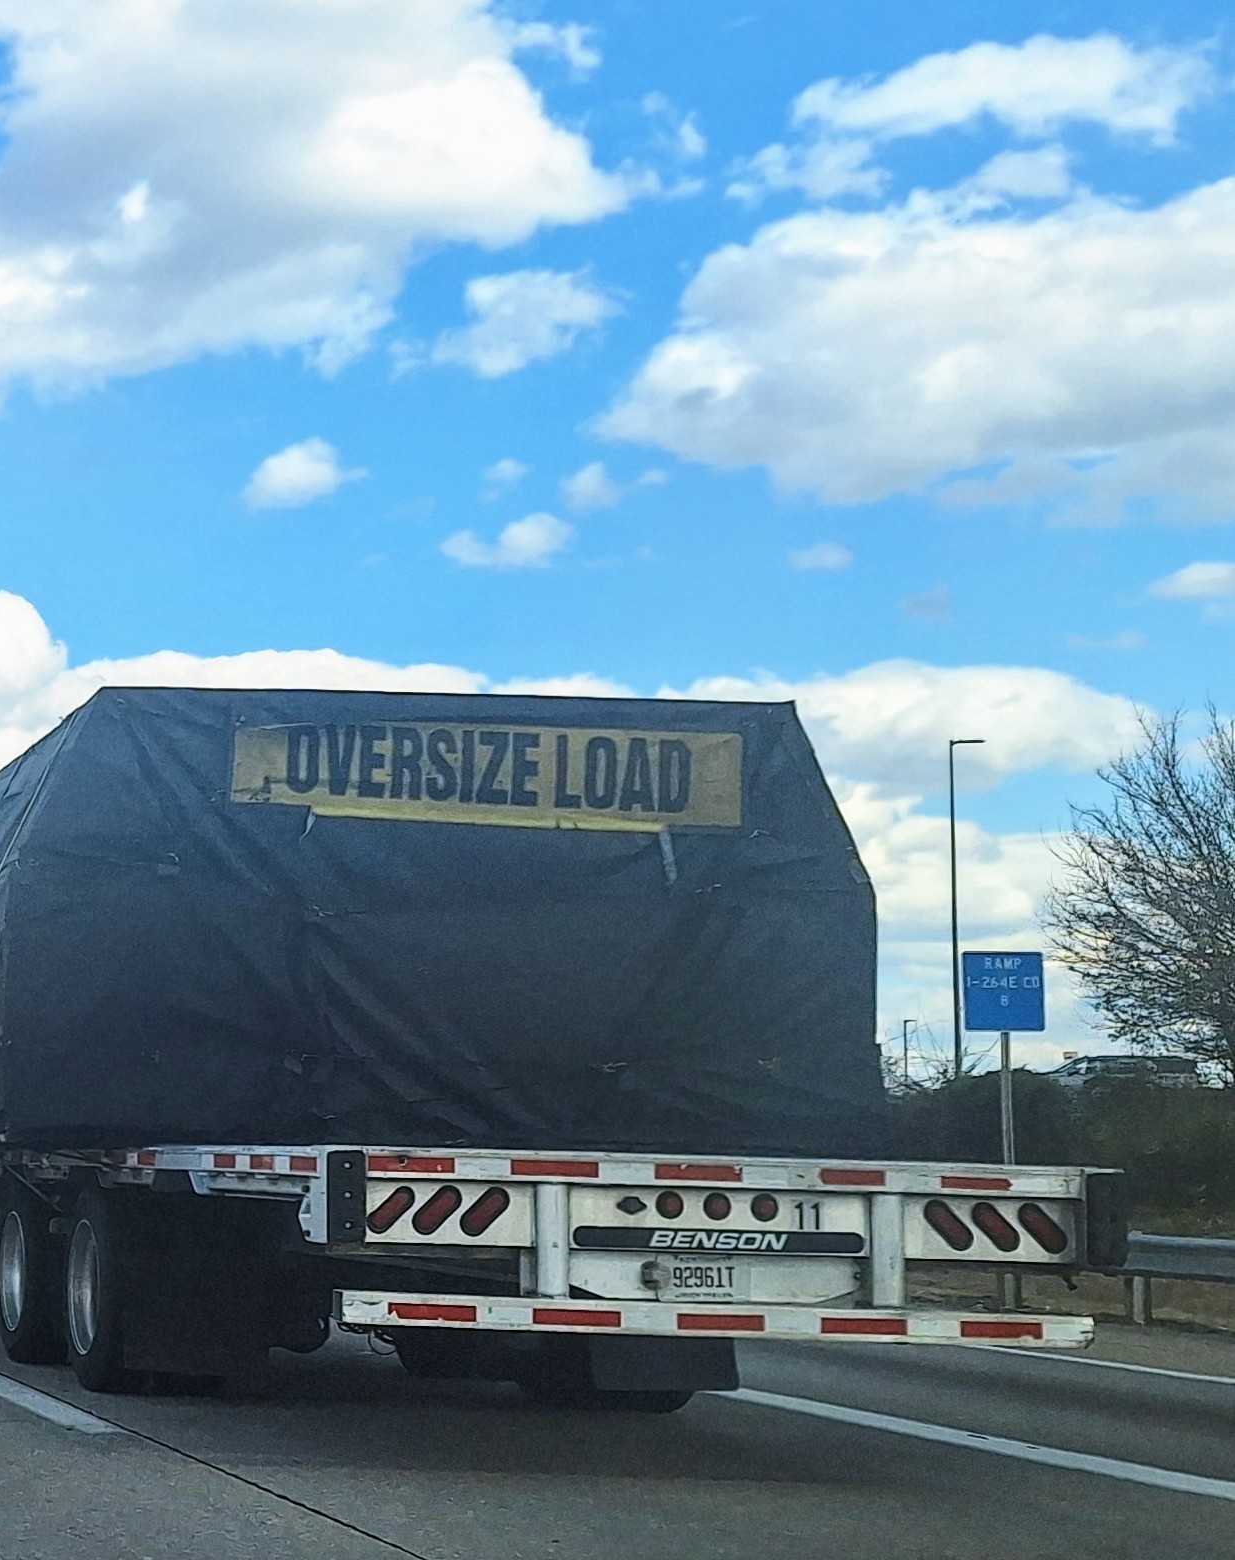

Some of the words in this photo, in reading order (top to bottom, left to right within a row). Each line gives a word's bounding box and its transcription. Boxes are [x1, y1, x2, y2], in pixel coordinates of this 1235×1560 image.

[284, 722, 542, 807] OVERSIZE
[553, 733, 693, 813] LOAD
[984, 957, 1022, 970] RAMP
[794, 1201, 821, 1231] 11
[649, 1230, 789, 1251] BENSON
[673, 1266, 735, 1288] 92961T
